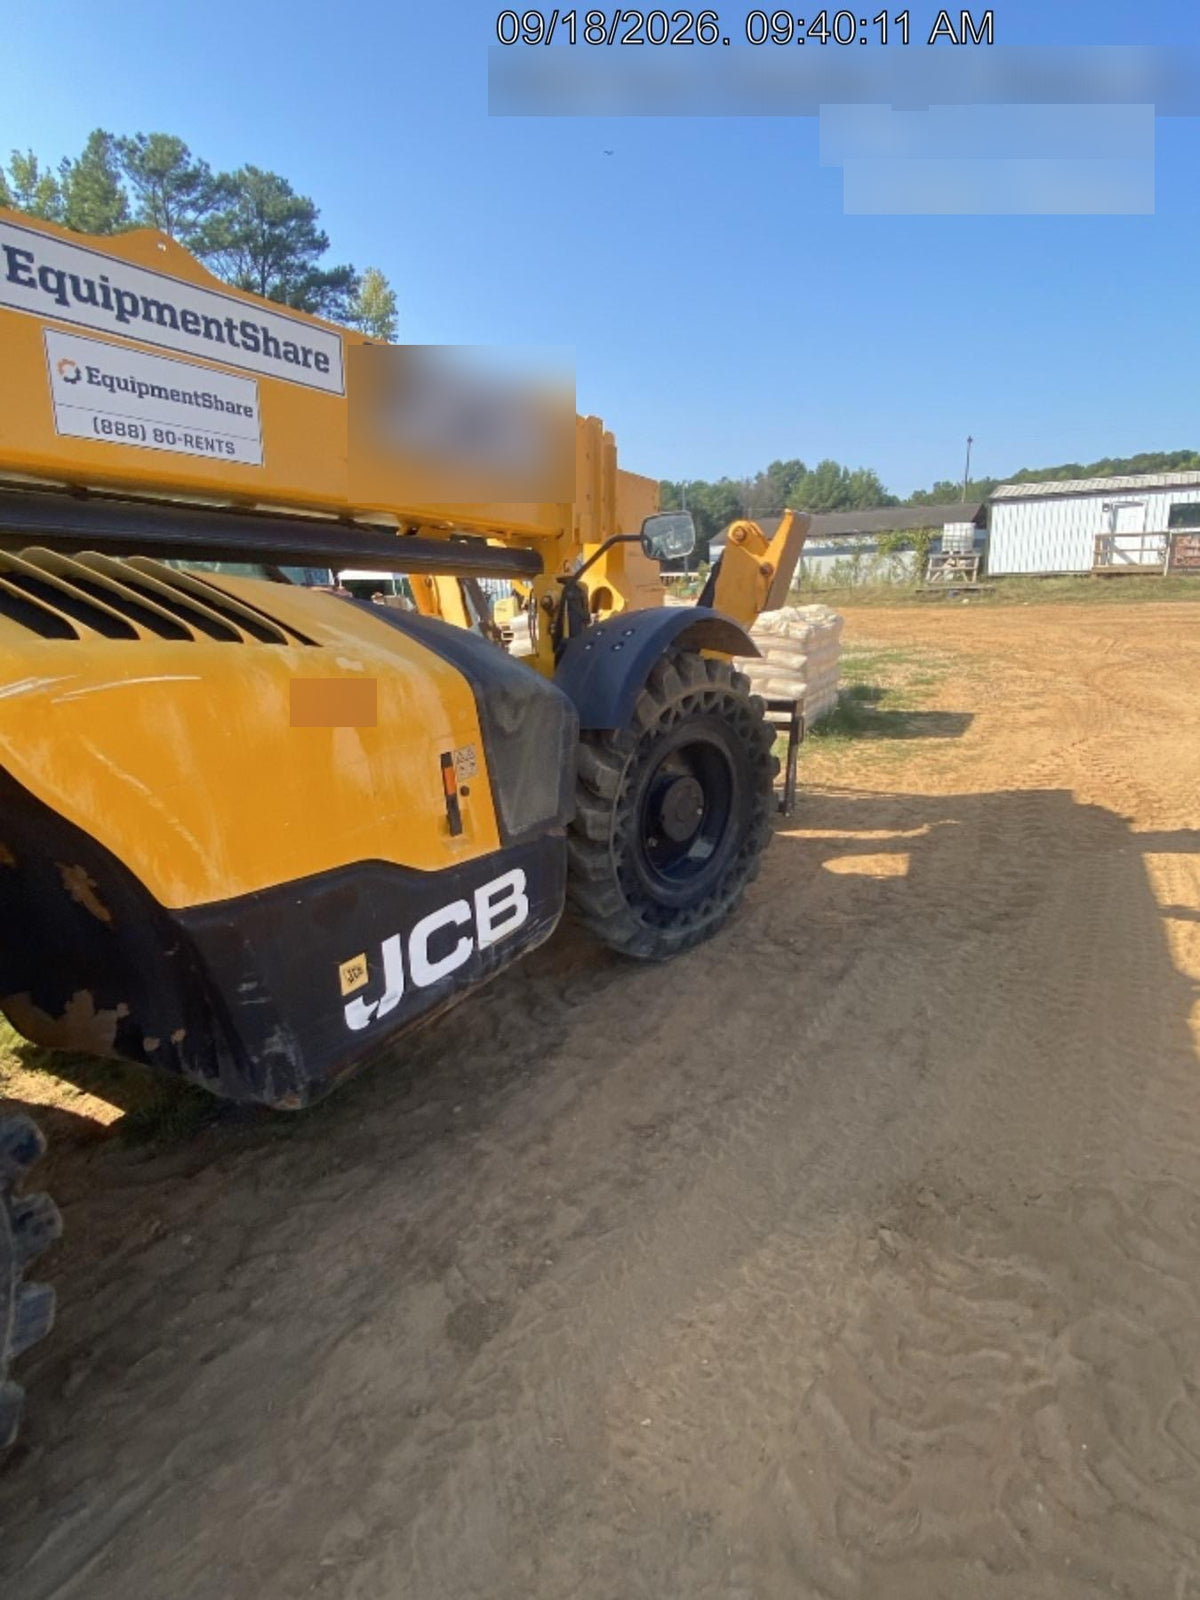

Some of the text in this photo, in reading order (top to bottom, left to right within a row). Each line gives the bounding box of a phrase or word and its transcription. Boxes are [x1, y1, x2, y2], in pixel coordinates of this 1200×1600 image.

[1, 244, 330, 374] EquipmentShare
[85, 365, 253, 418] EquipmentShare
[93, 416, 236, 455] (888) 80-RENTS
[344, 868, 529, 1031] JCB
